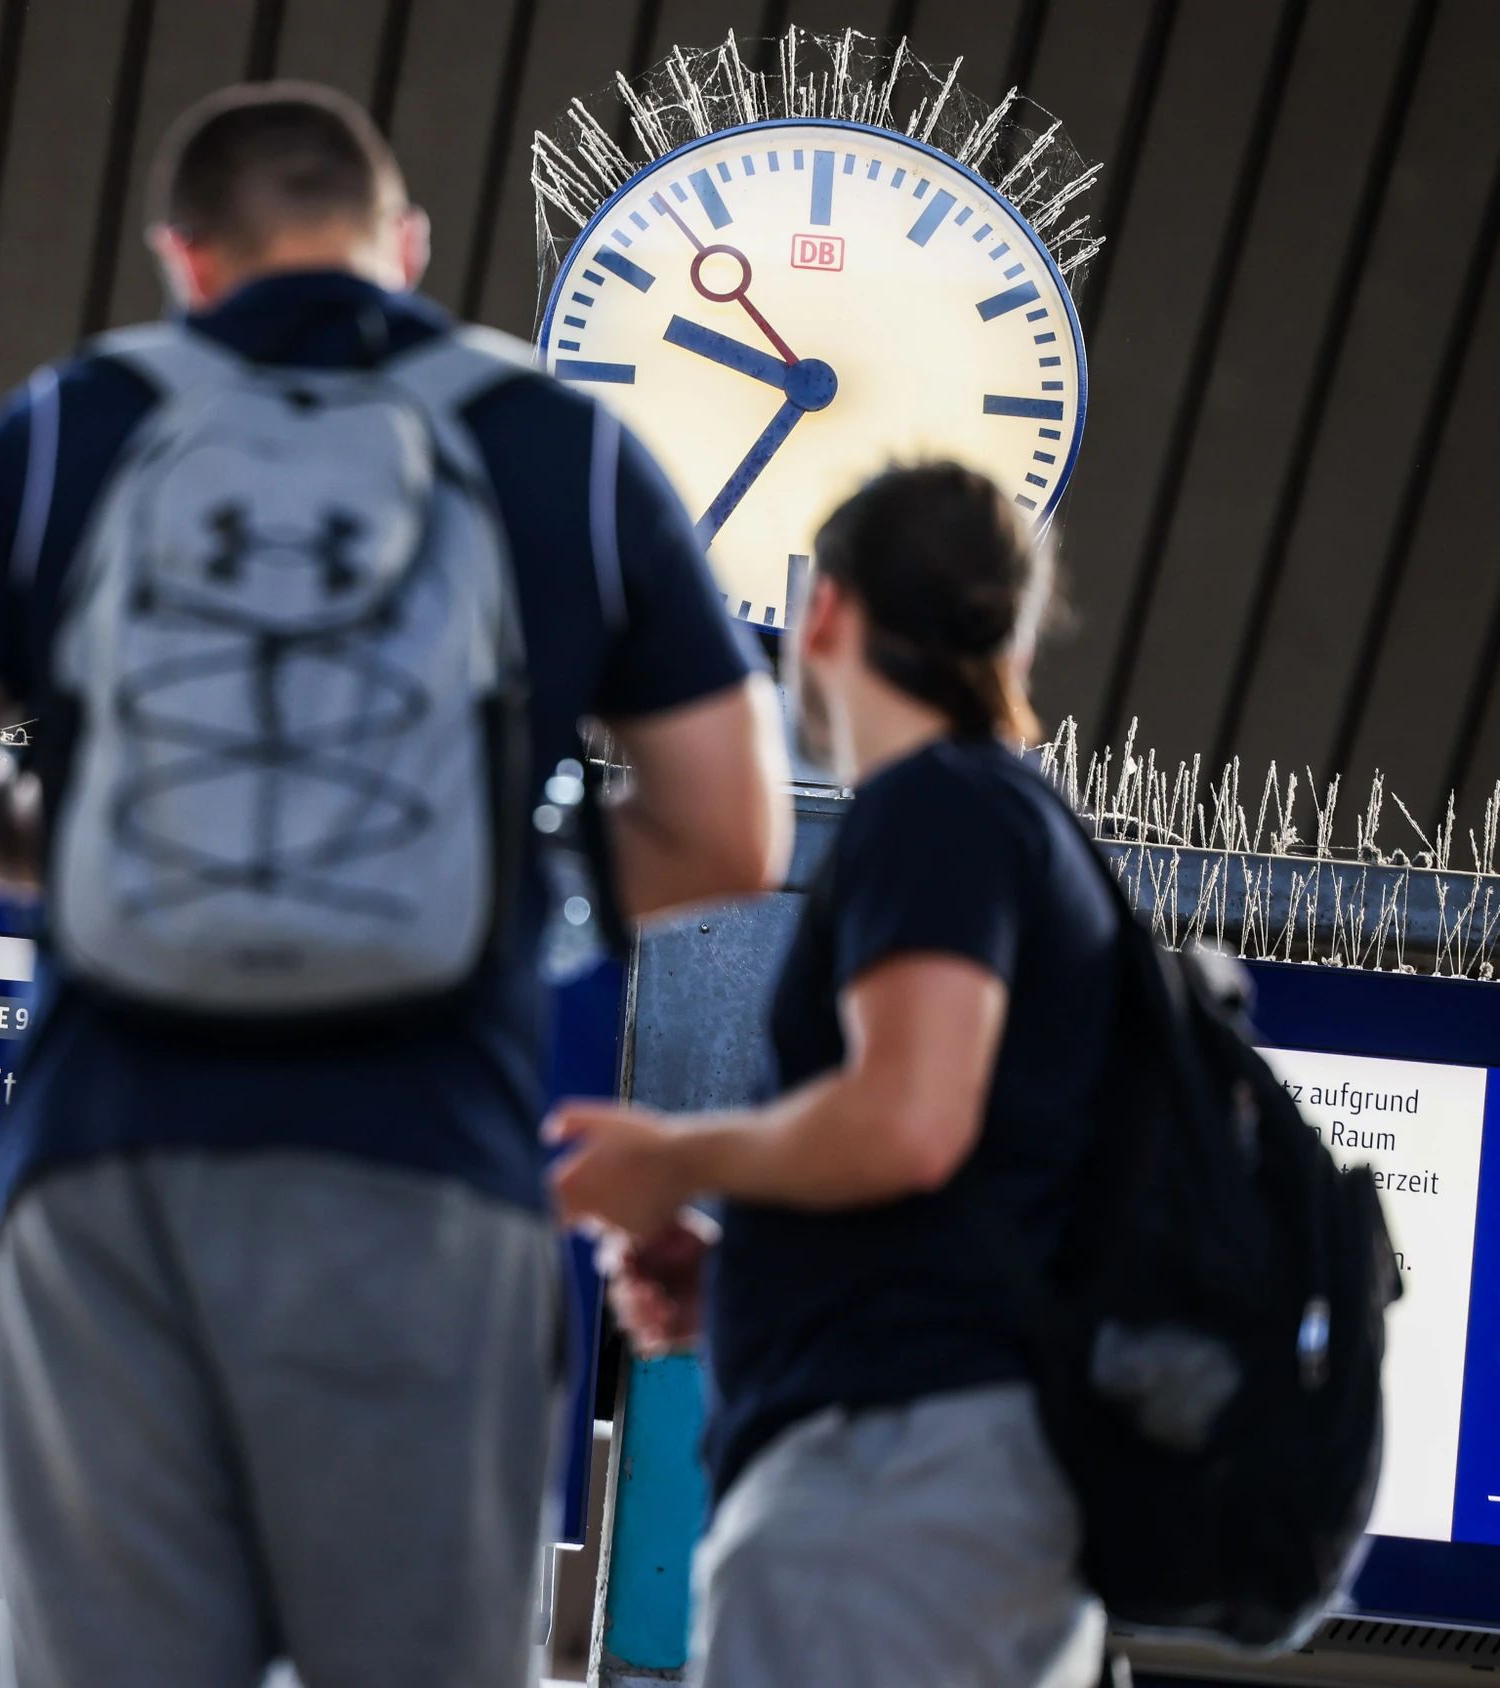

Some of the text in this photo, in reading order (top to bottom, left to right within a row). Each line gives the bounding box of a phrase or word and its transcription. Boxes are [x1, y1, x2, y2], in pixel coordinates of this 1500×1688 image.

[800, 239, 836, 266] DB
[15, 1007, 33, 1031] 9
[1310, 1082, 1420, 1116] aufgrund
[1330, 1120, 1396, 1151] Raum
[1366, 1162, 1440, 1195] erzeit
